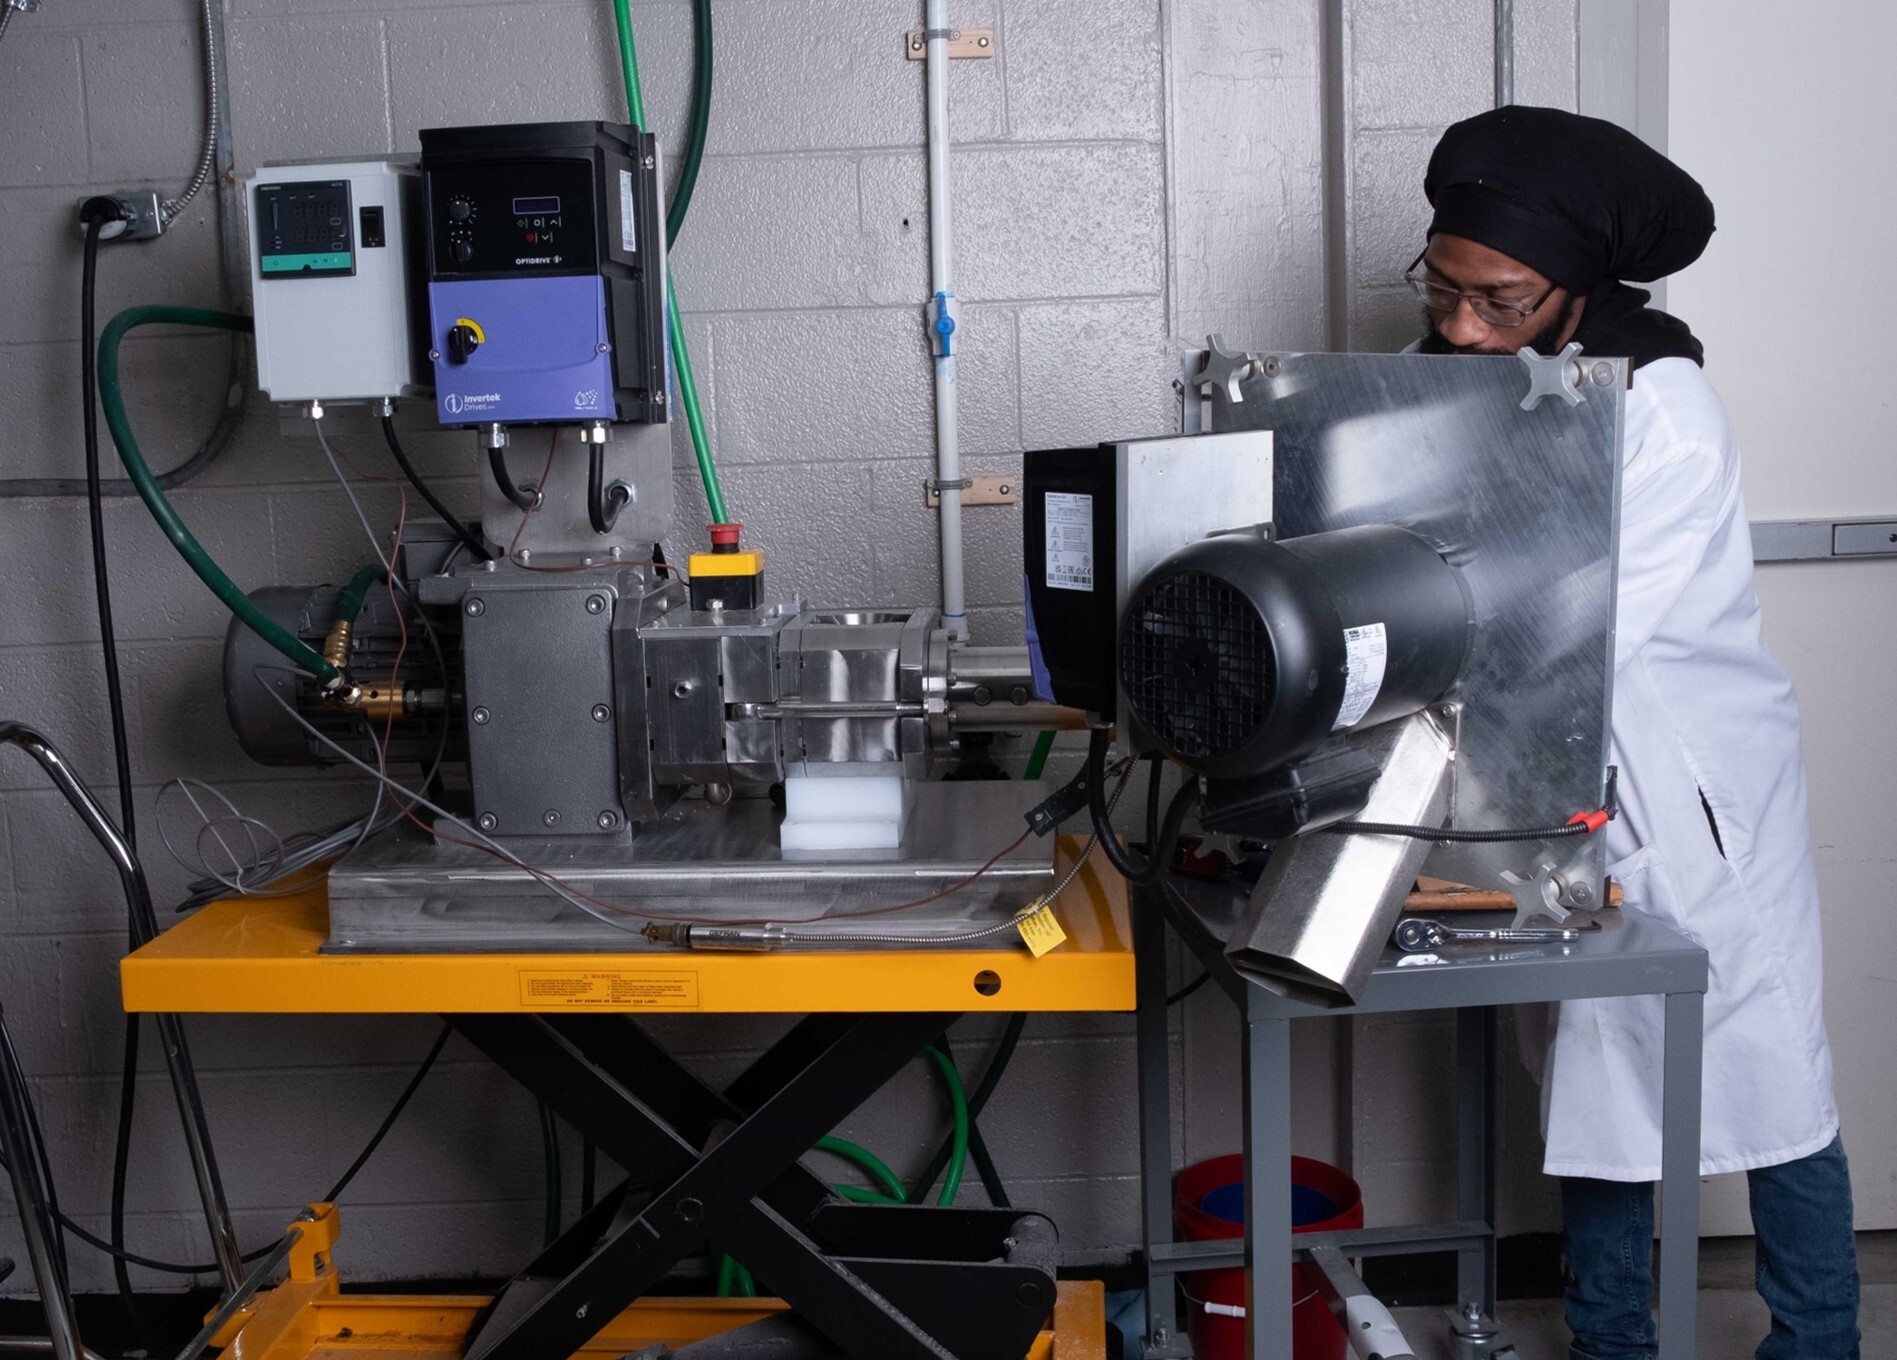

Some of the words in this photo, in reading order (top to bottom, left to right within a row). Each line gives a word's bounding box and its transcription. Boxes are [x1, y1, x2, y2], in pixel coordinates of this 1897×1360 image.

[515, 257, 551, 265] OPTIDRIVE
[464, 393, 501, 403] Invertek
[708, 929, 741, 937] GEFRAN
